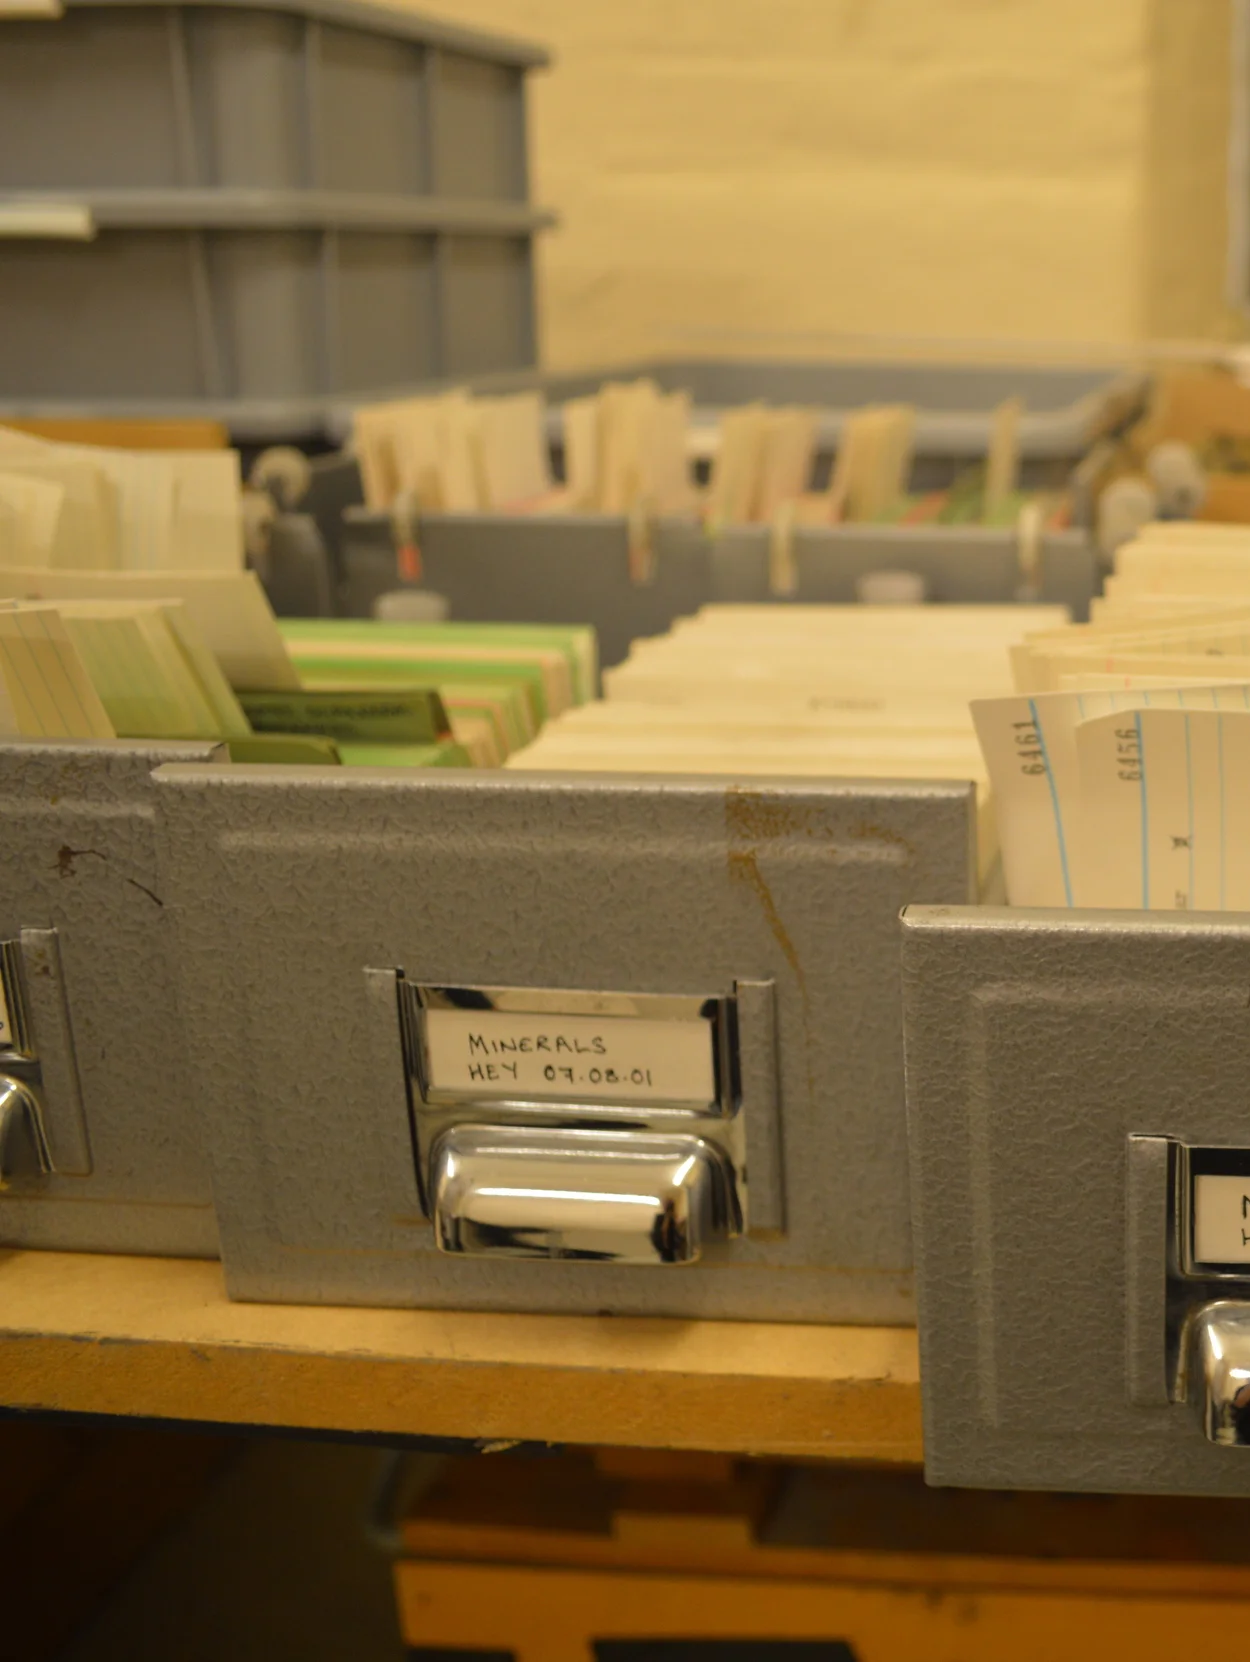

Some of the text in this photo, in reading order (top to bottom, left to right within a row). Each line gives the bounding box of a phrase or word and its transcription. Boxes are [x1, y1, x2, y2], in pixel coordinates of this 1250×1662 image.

[1012, 720, 1047, 776] 6461
[1114, 728, 1144, 782] 6456
[468, 1033, 608, 1056] MINERALS
[468, 1061, 654, 1087] HEY 07.08.01
